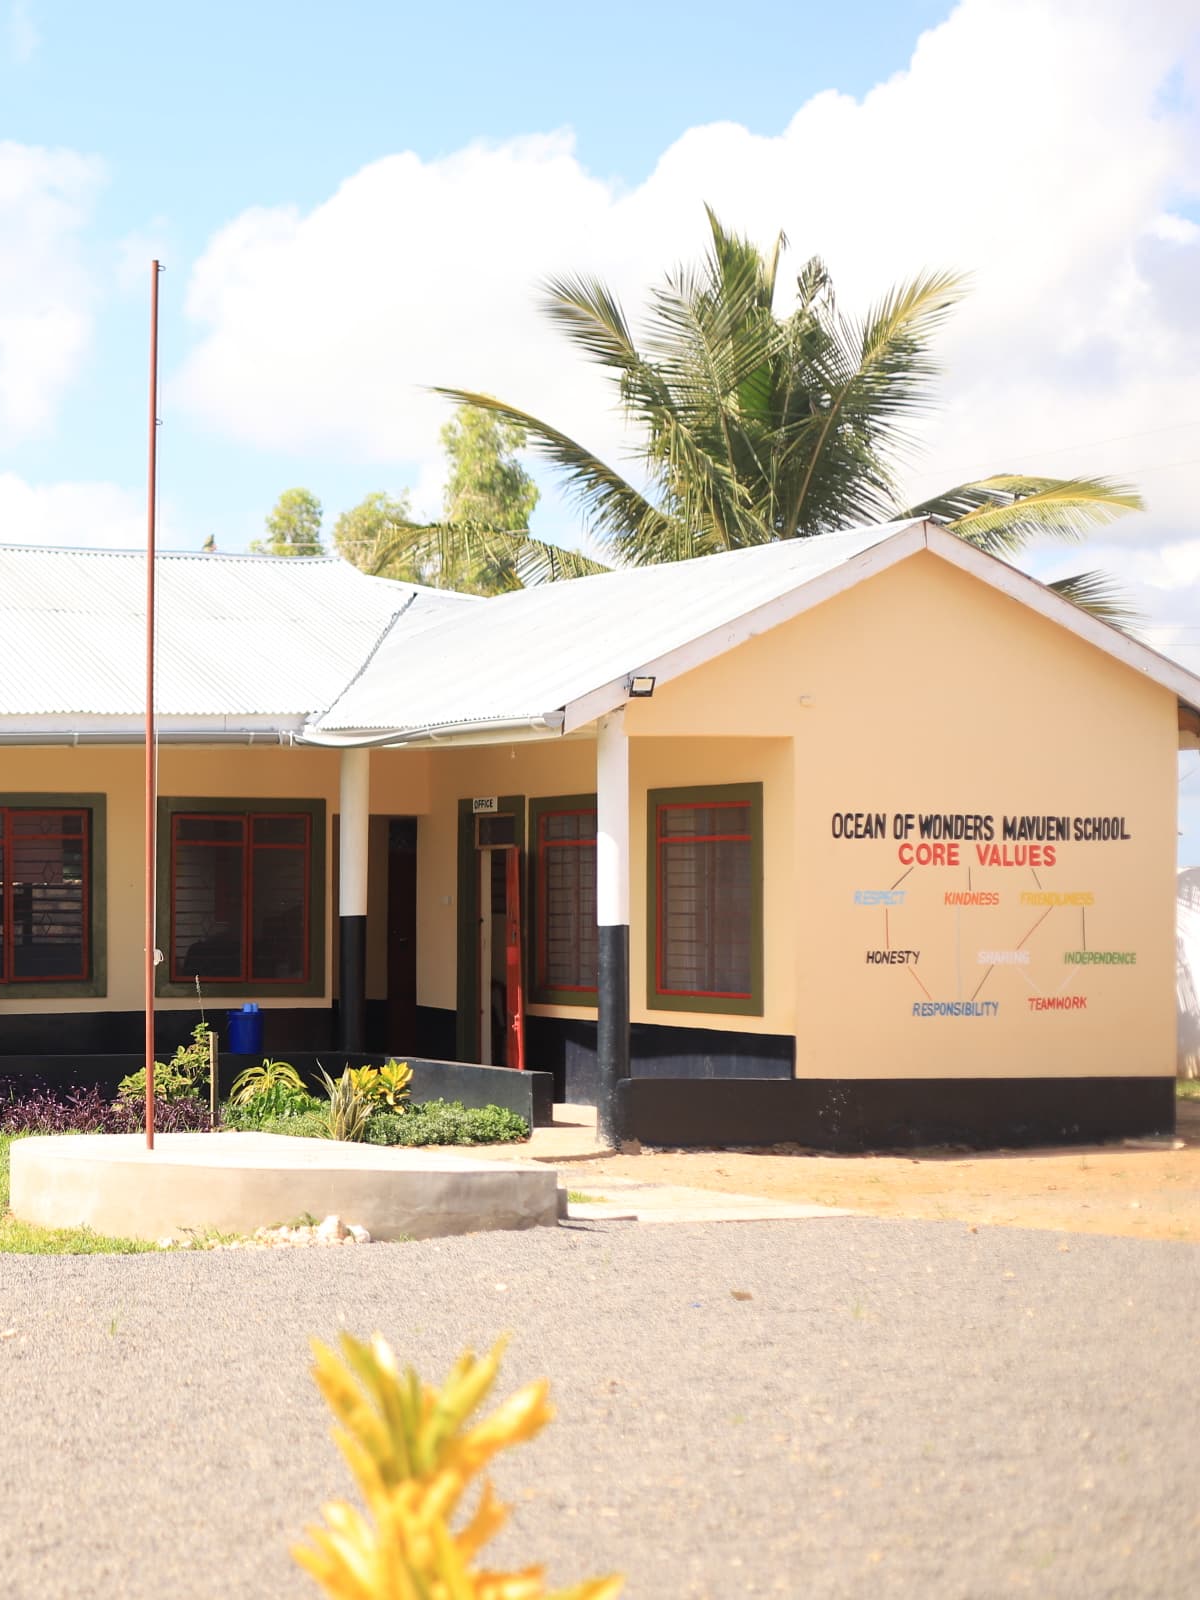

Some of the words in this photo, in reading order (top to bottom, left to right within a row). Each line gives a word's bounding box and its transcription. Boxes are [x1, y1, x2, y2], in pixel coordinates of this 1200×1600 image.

[832, 813, 886, 839] OCEAN
[893, 813, 915, 839] OF
[918, 814, 995, 841] WONDERS
[1002, 815, 1070, 841] MAVUENI
[1074, 817, 1131, 841] SCHOOL
[898, 843, 960, 866] CORE
[976, 844, 1057, 867] VALUES
[944, 892, 999, 905] KINDNESS
[866, 951, 920, 964] HONESTY
[1064, 951, 1136, 965] INDEPENDENCE
[912, 1001, 999, 1017] RESPONSIBILITY
[1028, 996, 1087, 1011] TEAMWORK
